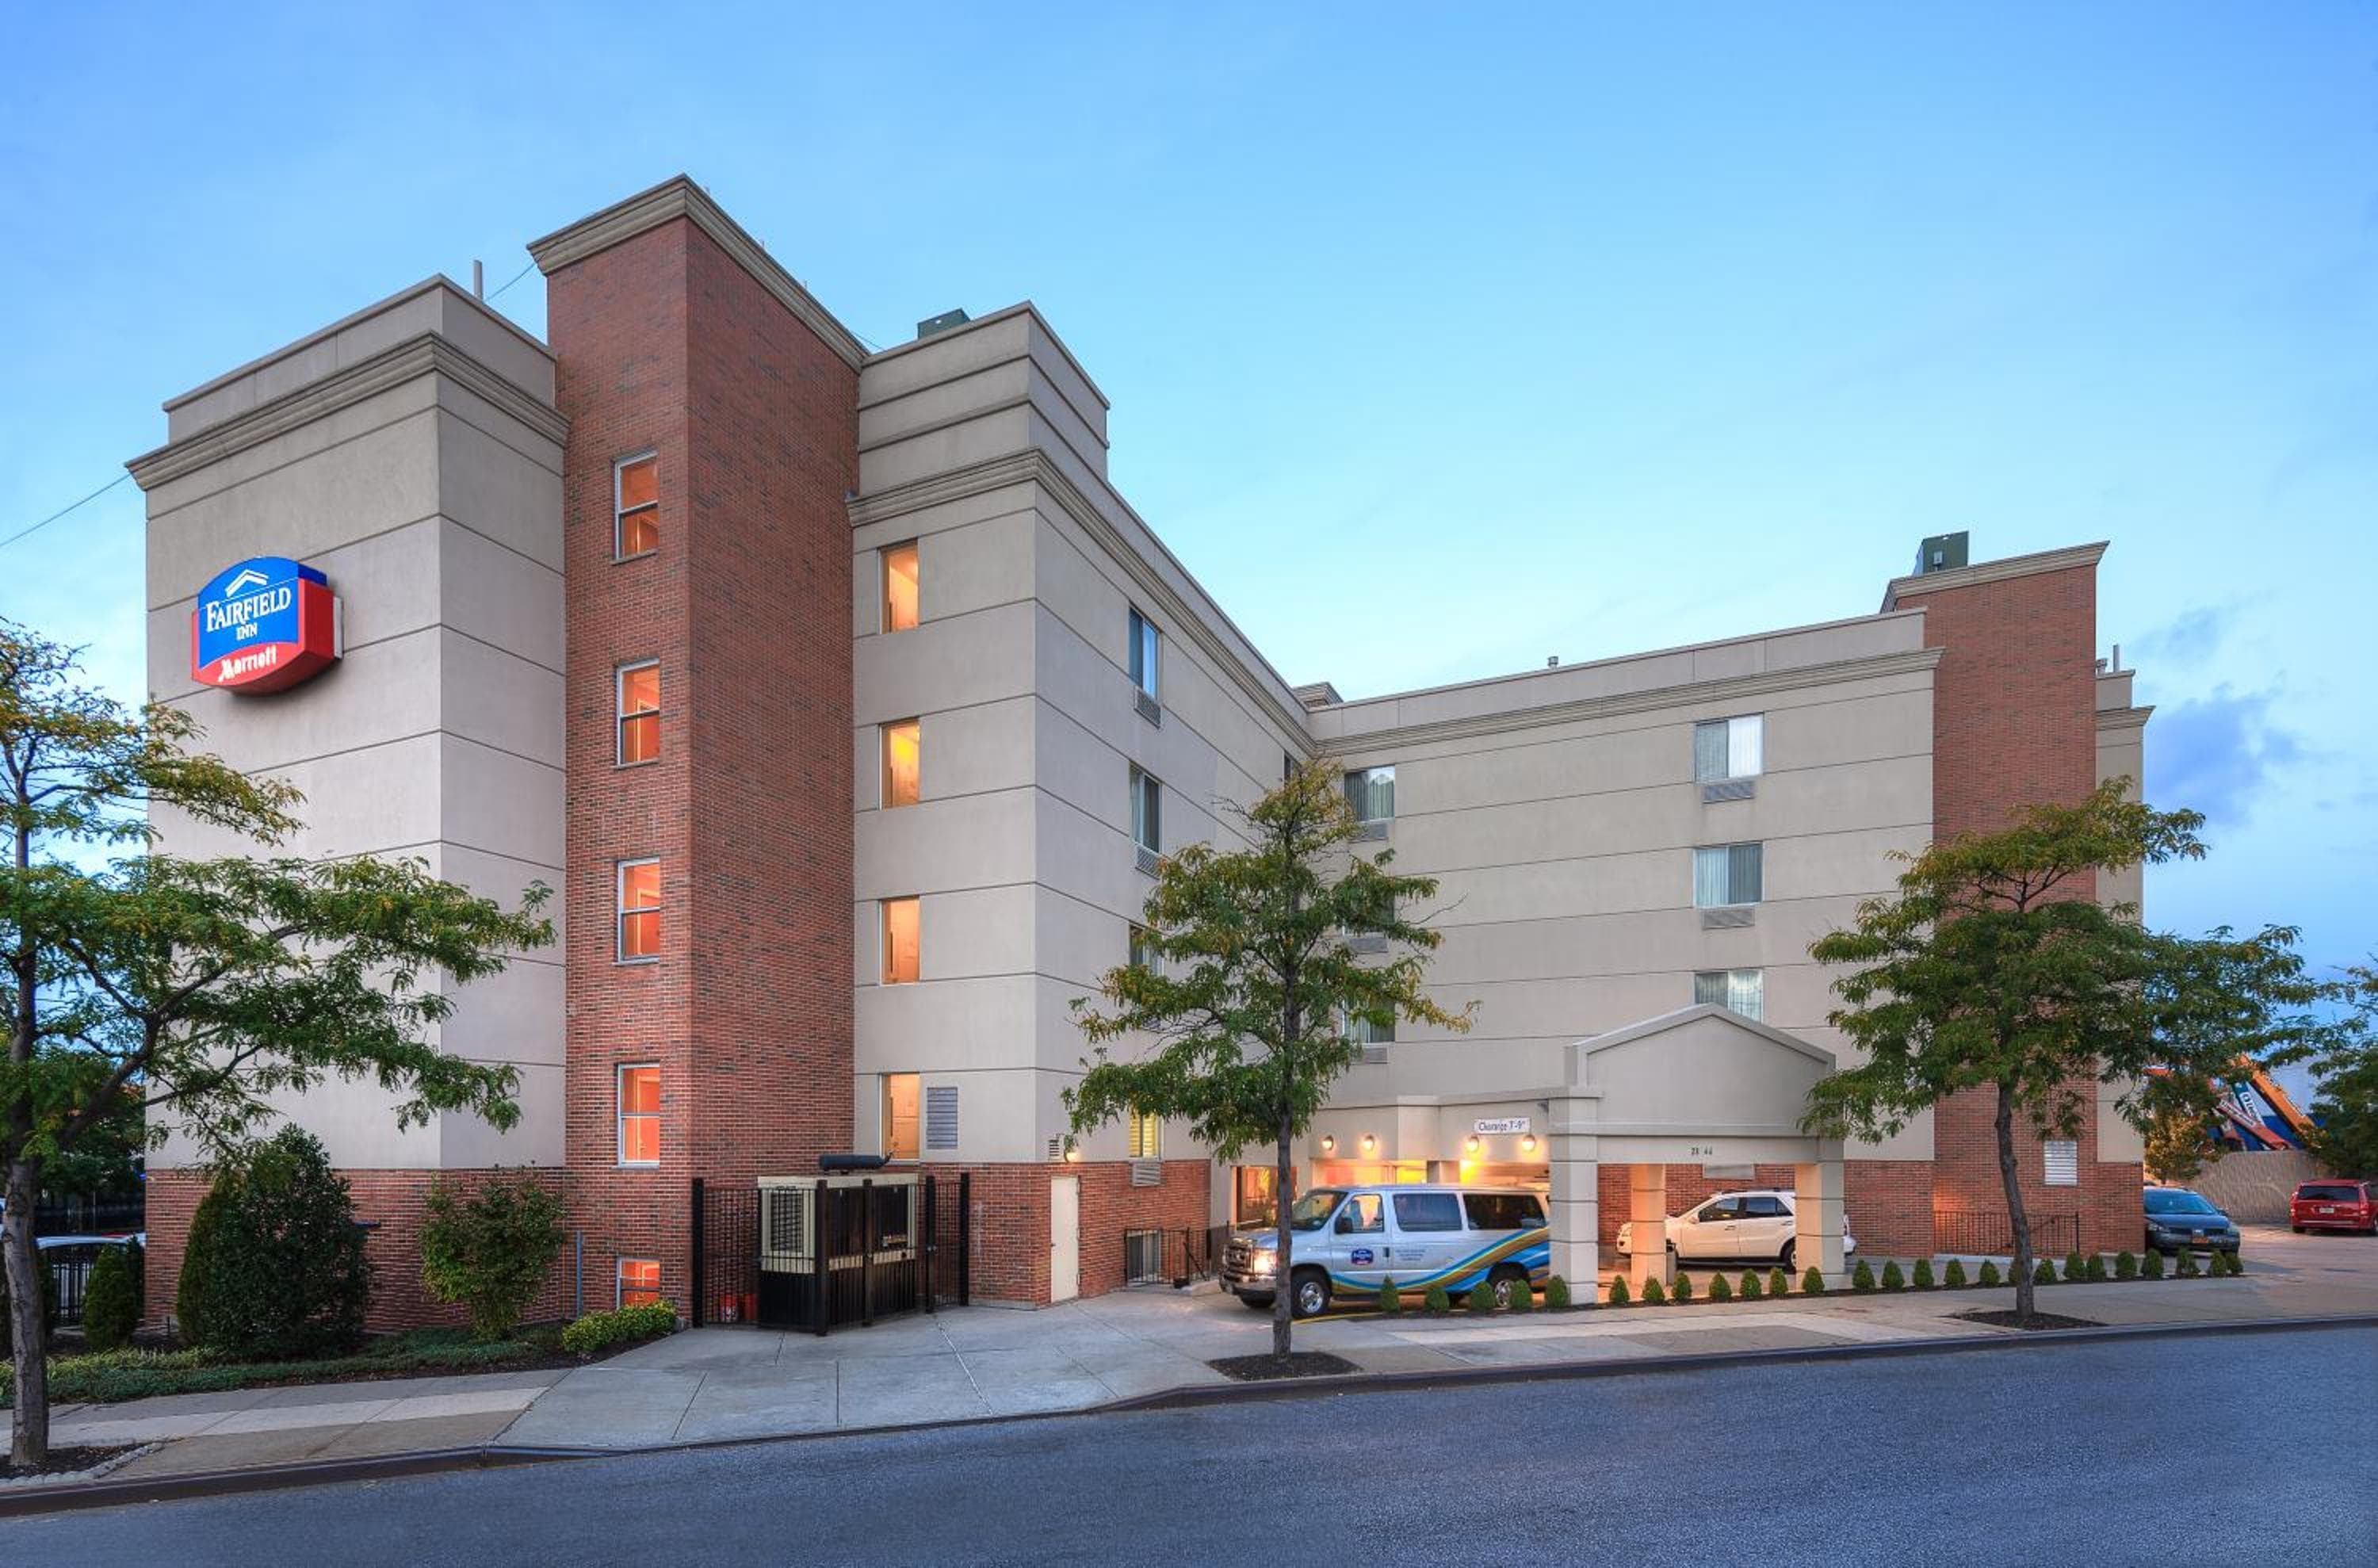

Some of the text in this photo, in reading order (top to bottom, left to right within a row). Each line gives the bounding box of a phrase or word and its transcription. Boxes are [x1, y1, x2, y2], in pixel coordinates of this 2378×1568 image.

[206, 587, 292, 633] FAIRFIELD
[236, 622, 258, 641] INN
[218, 644, 277, 683] Marriott
